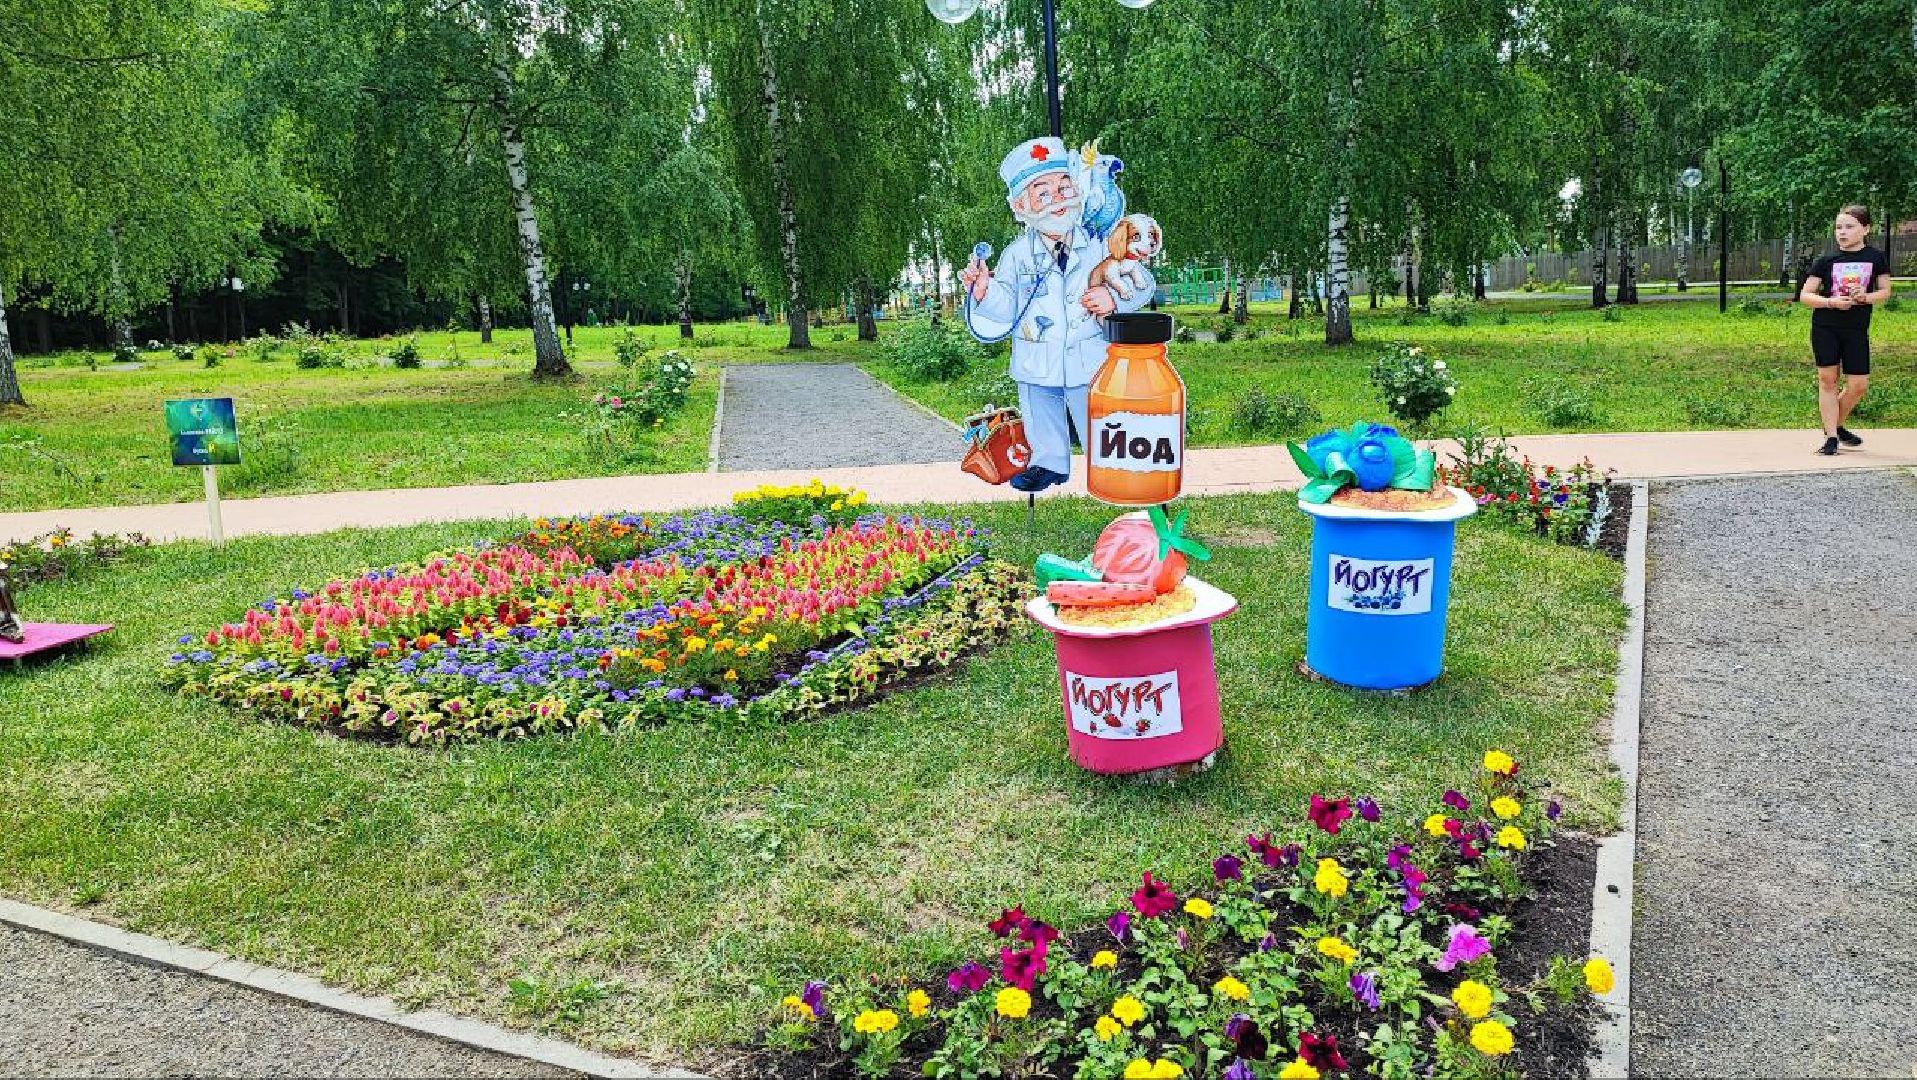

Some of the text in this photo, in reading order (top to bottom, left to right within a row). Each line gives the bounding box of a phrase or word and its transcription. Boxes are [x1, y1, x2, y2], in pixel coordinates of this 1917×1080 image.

[1100, 422, 1174, 464] Йод
[1334, 559, 1430, 596] ЙОГУРТ
[1072, 678, 1172, 717] ЙОГУРТ
